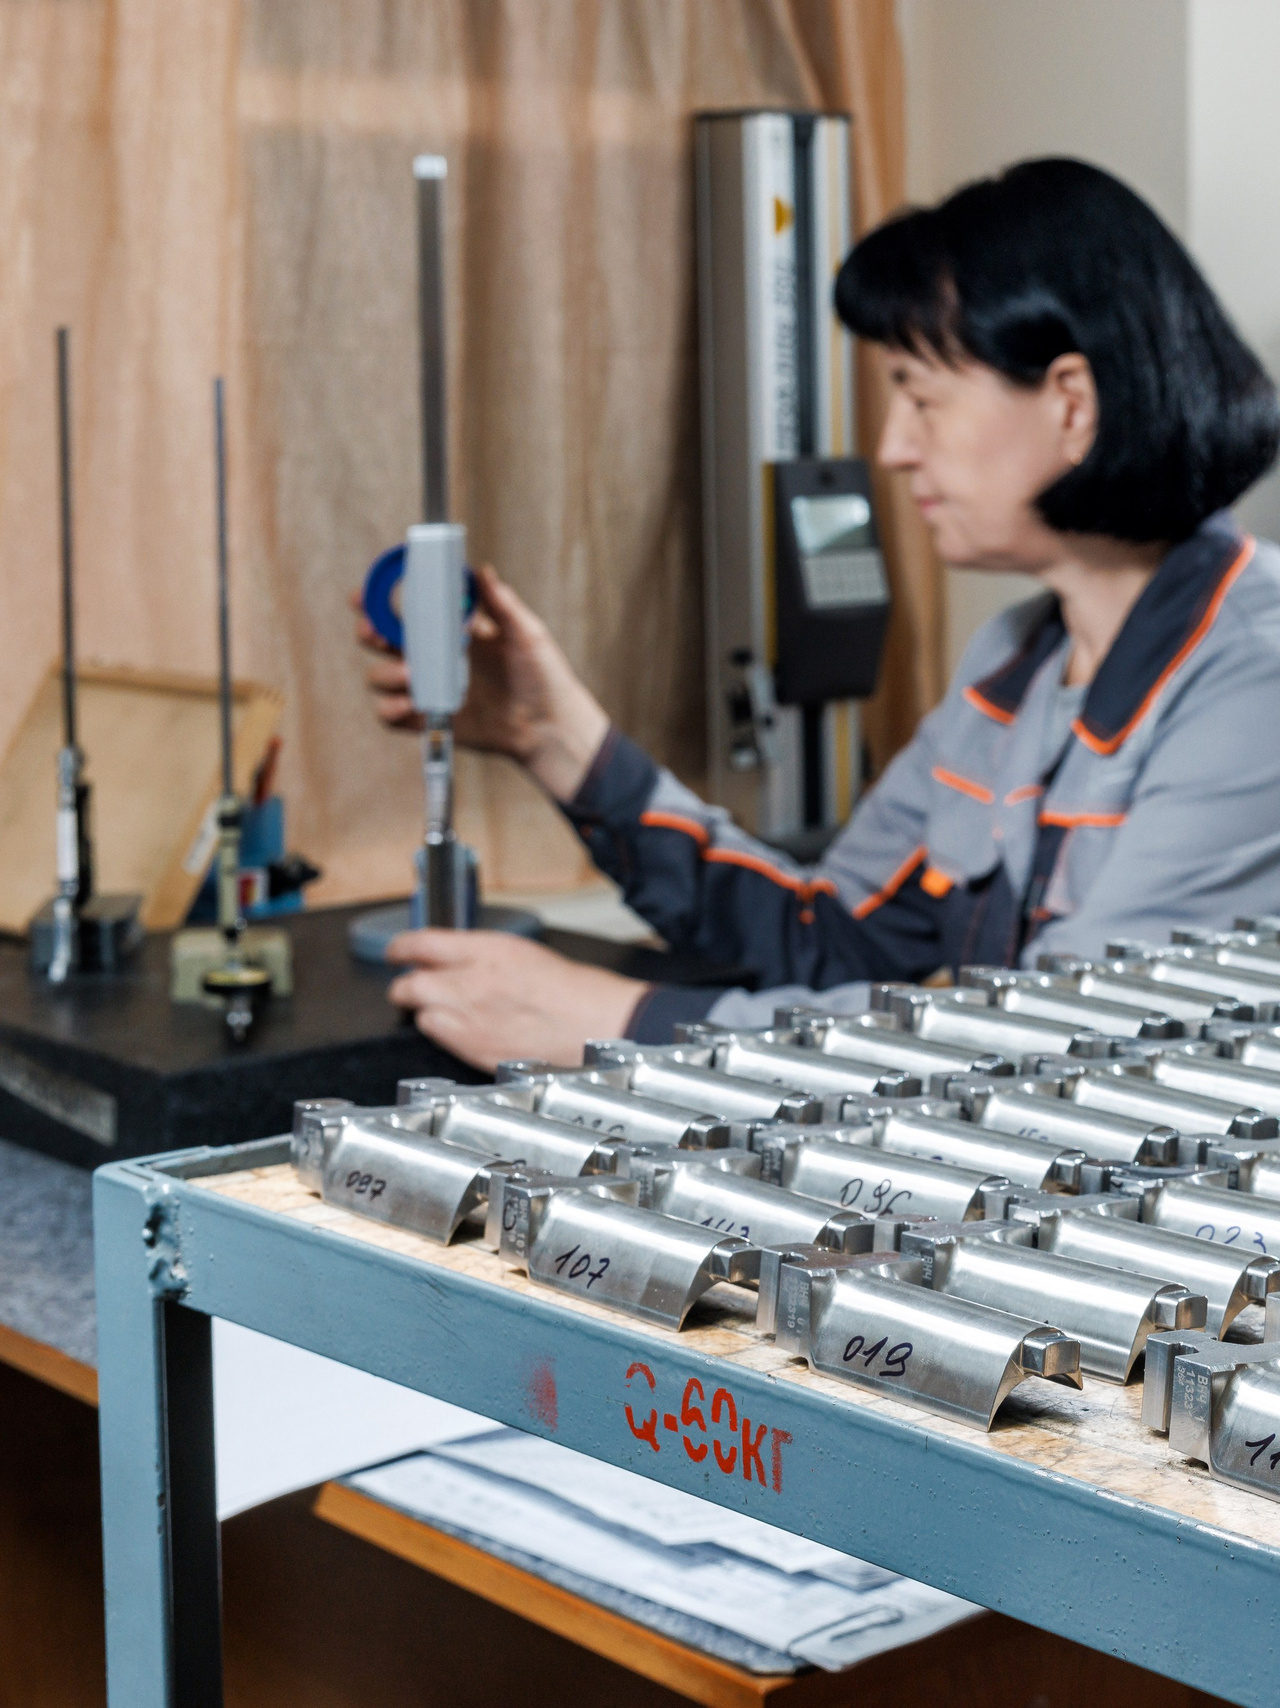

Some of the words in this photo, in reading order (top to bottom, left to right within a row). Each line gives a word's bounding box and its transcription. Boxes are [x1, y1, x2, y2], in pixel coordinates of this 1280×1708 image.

[345, 1169, 387, 1201] 097
[554, 1244, 610, 1289] 107
[843, 1335, 913, 1377] 019
